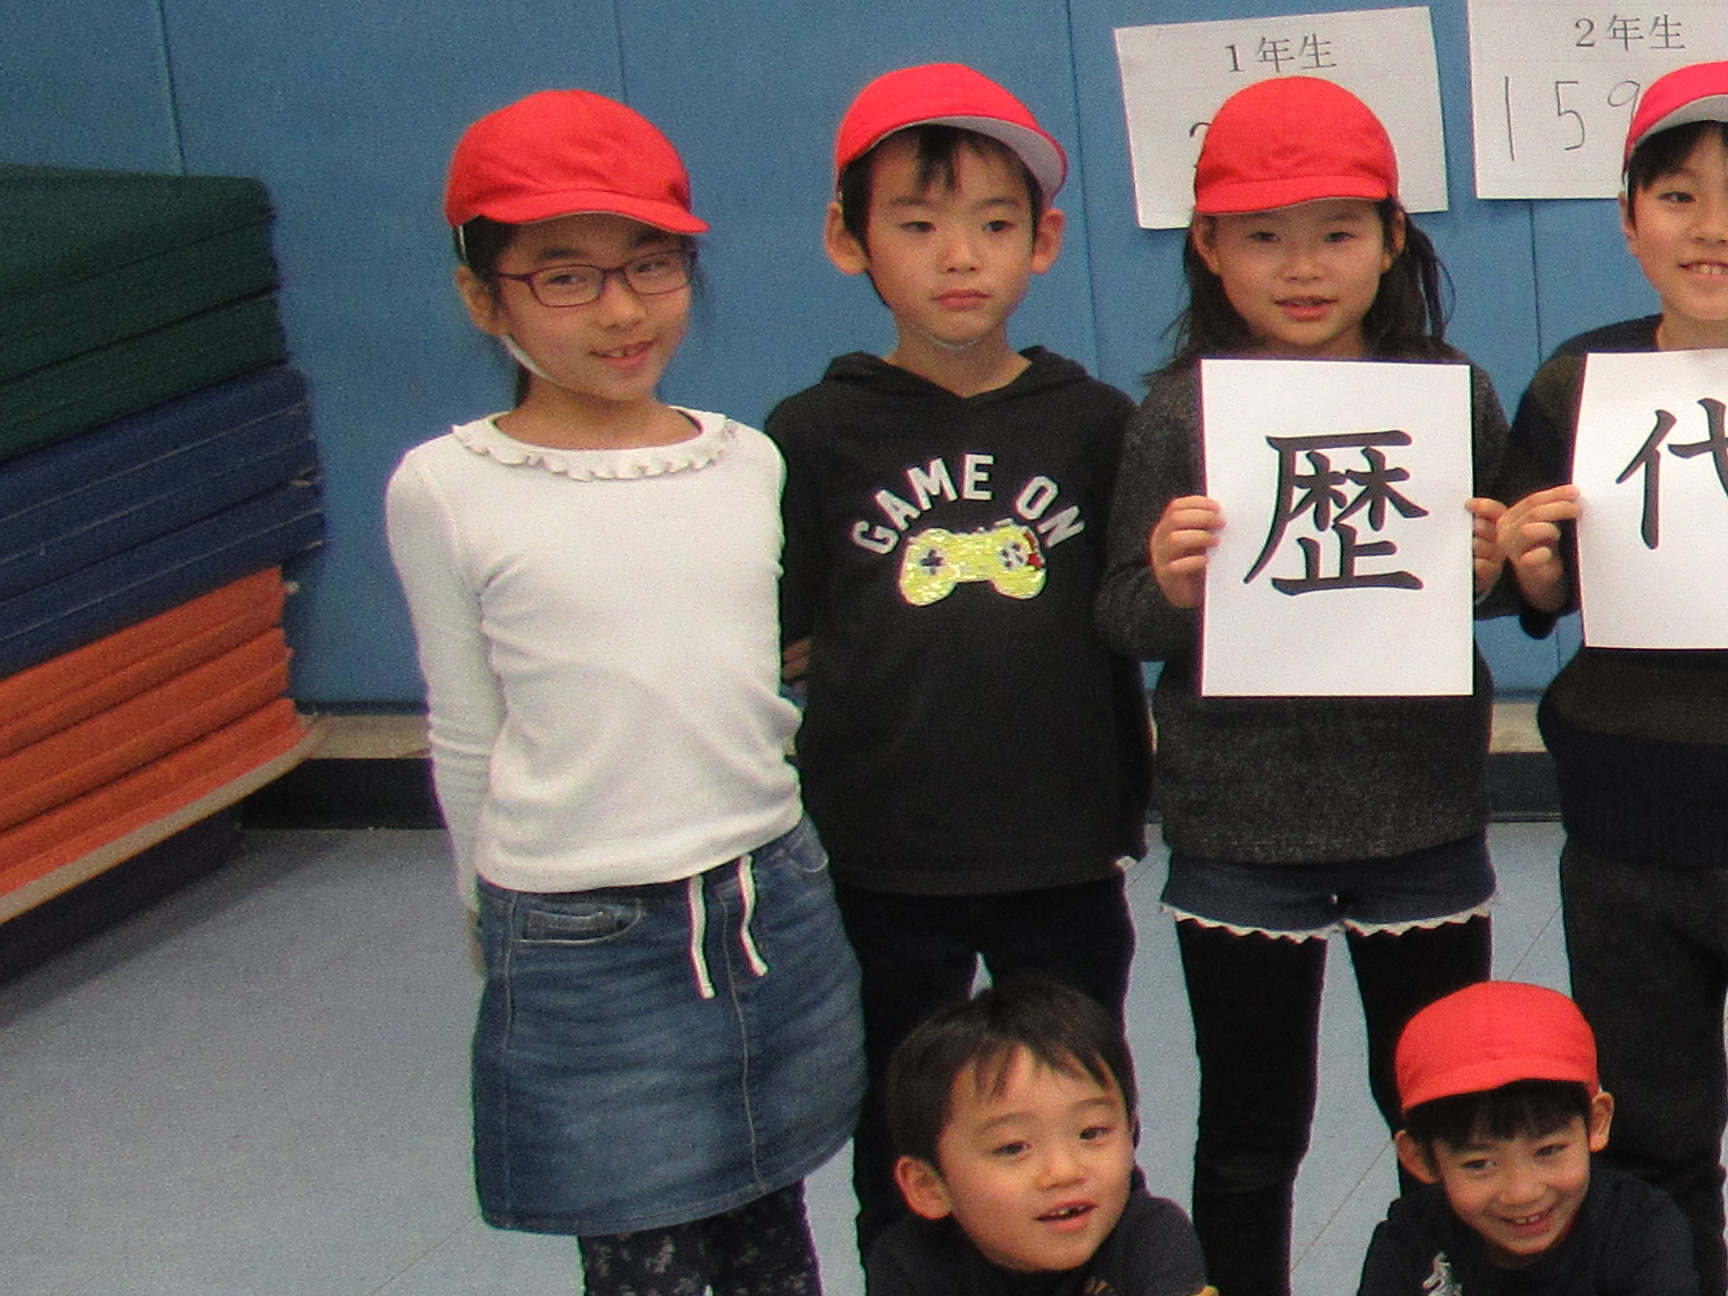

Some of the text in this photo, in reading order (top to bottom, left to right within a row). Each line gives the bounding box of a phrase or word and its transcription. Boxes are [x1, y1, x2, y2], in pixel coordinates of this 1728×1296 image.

[1224, 32, 1338, 75] 1年生
[1573, 13, 1687, 51] 2年生
[850, 452, 1086, 555] GAME ON
[1242, 427, 1431, 599] 歴
